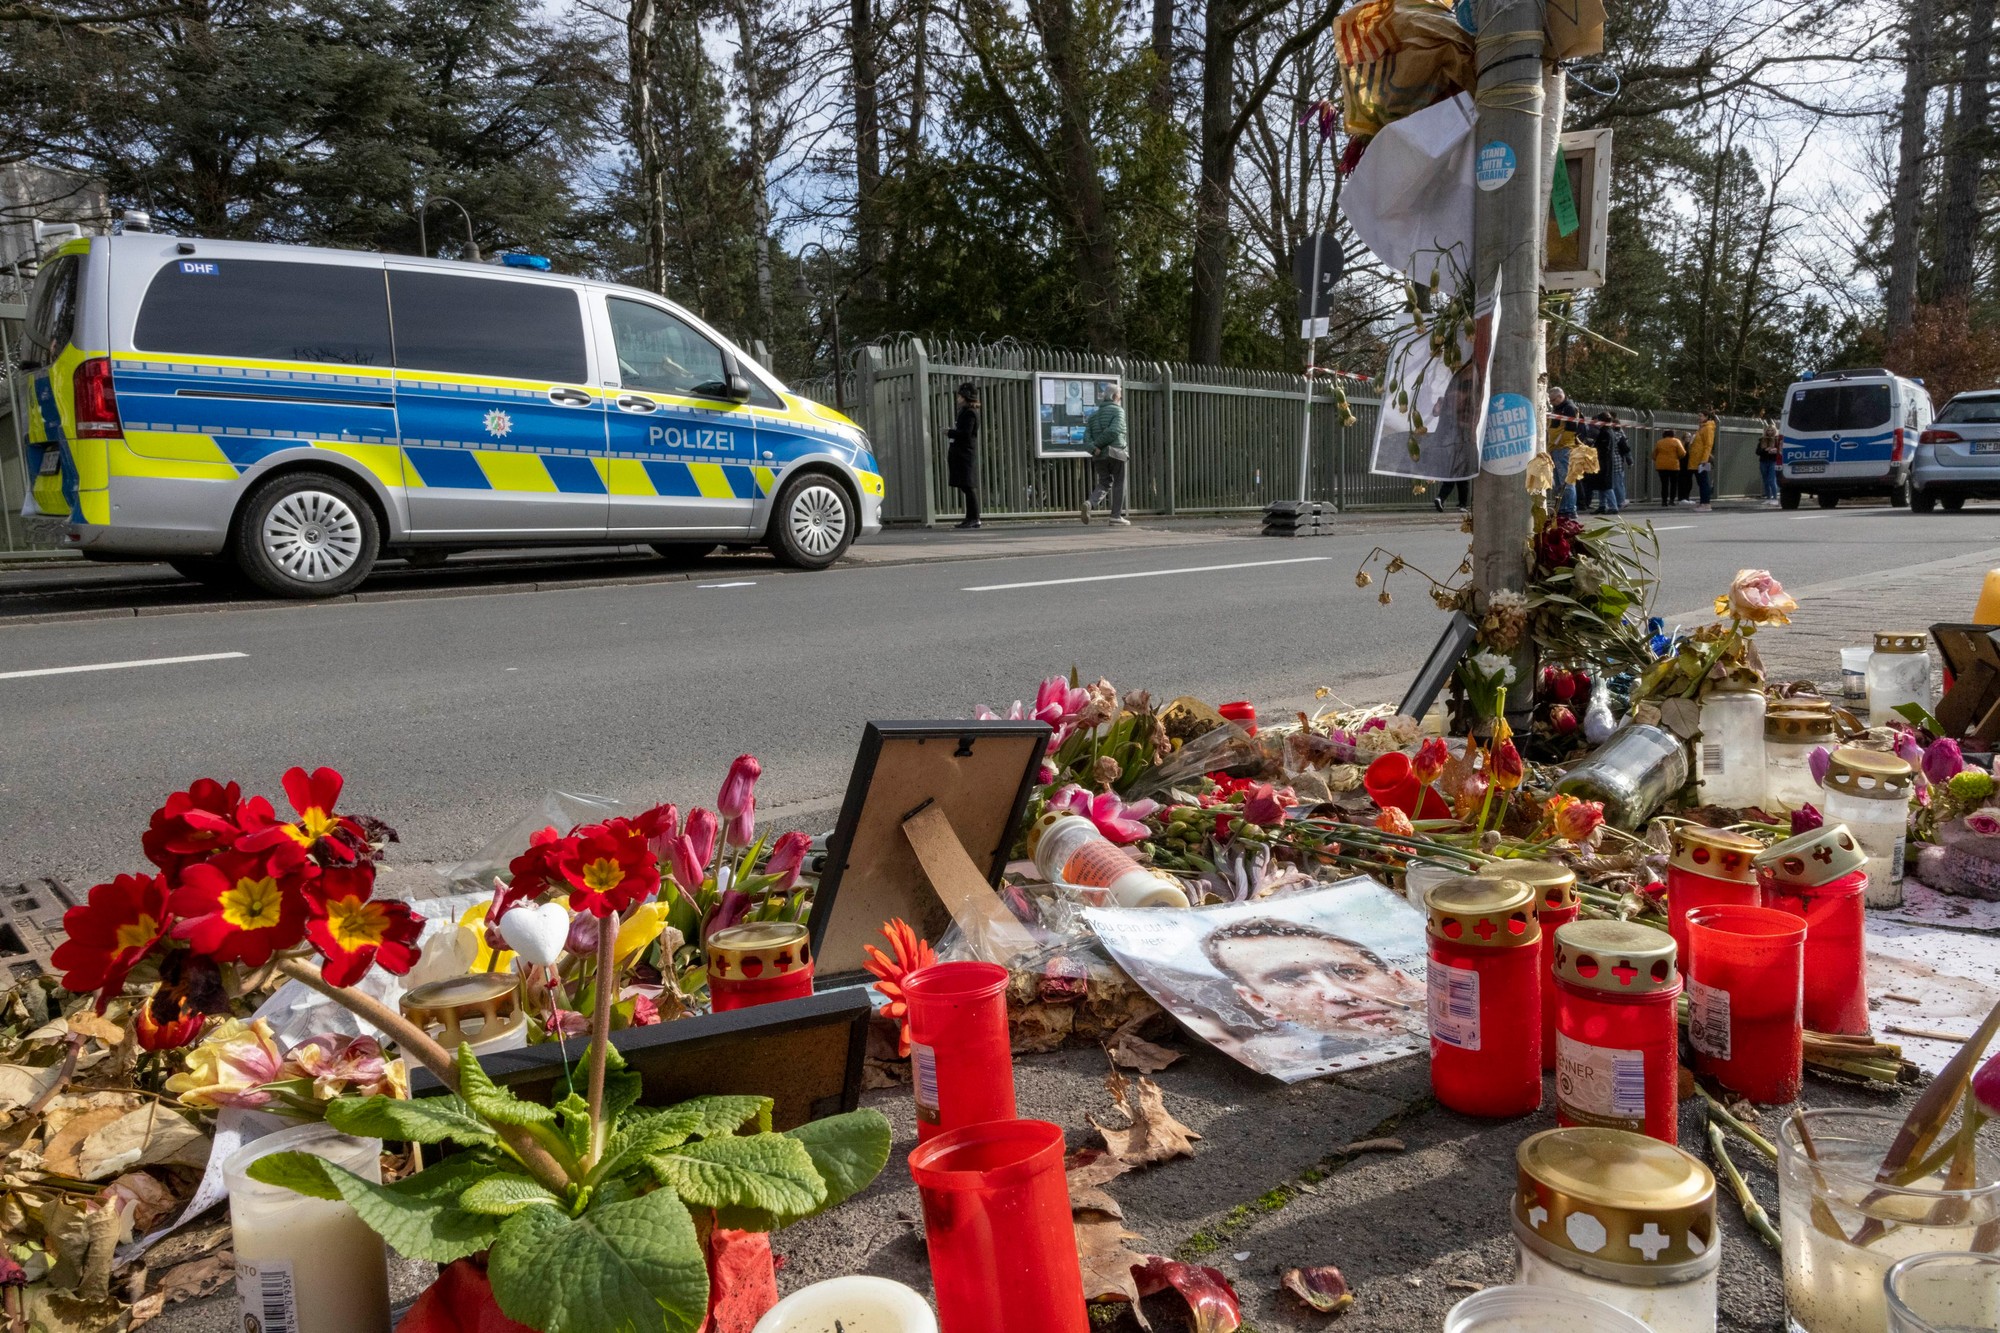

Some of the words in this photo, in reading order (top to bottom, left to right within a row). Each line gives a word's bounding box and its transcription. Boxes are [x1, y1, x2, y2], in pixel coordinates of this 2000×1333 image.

[1481, 147, 1506, 159] STAND
[1482, 158, 1503, 170] WITH
[184, 263, 213, 273] DHF
[1507, 422, 1529, 439] DIE
[649, 426, 735, 451] POLIZEI
[1481, 438, 1532, 462] UKRAINE
[1975, 443, 1987, 451] BN
[1787, 450, 1830, 460] POLIZEI
[1090, 920, 1114, 932] You
[1117, 924, 1142, 932] can
